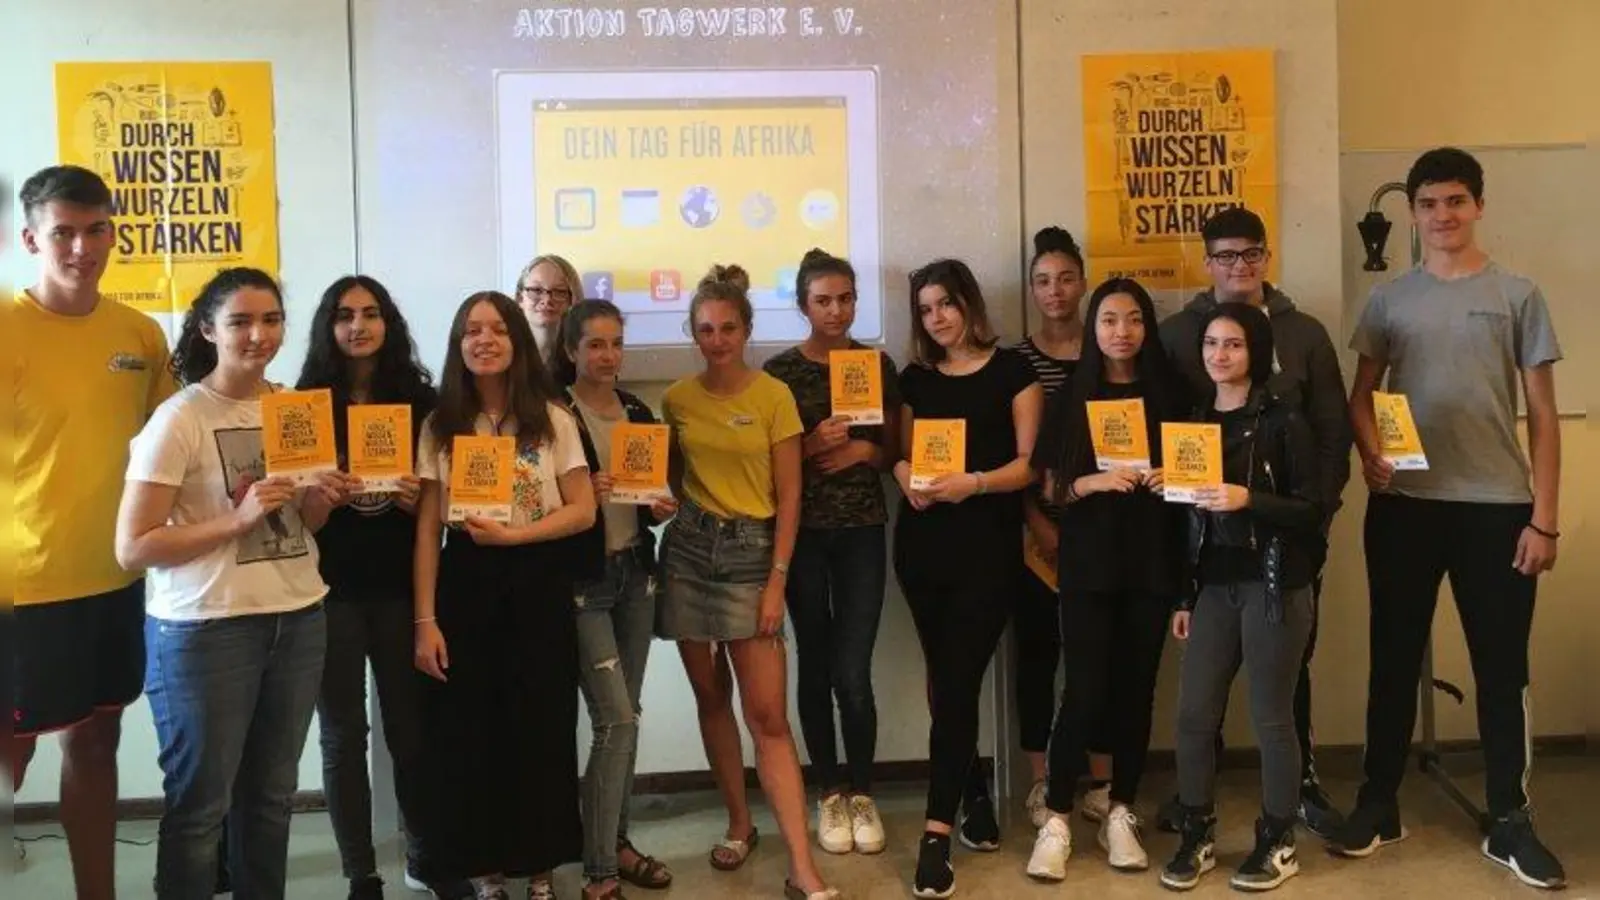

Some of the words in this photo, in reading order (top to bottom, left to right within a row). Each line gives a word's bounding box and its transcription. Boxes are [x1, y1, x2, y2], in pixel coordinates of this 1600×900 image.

[515, 9, 626, 38] AKTION
[637, 8, 788, 37] TAGWERK
[799, 8, 823, 36] E.
[833, 9, 863, 36] V.
[121, 122, 194, 147] DURCH
[1138, 108, 1203, 133] DURCH
[563, 126, 618, 160] DEIN
[627, 126, 669, 159] TAG
[679, 120, 722, 158] FÜR
[732, 124, 816, 157] AFRIKA
[1131, 134, 1227, 168] WISSEN
[112, 150, 222, 183] WISSEN
[1126, 169, 1233, 198] WURZELN
[110, 186, 229, 216] WURZELN
[1135, 199, 1245, 235] STÄRK
[117, 216, 243, 254] STÄRKEN
